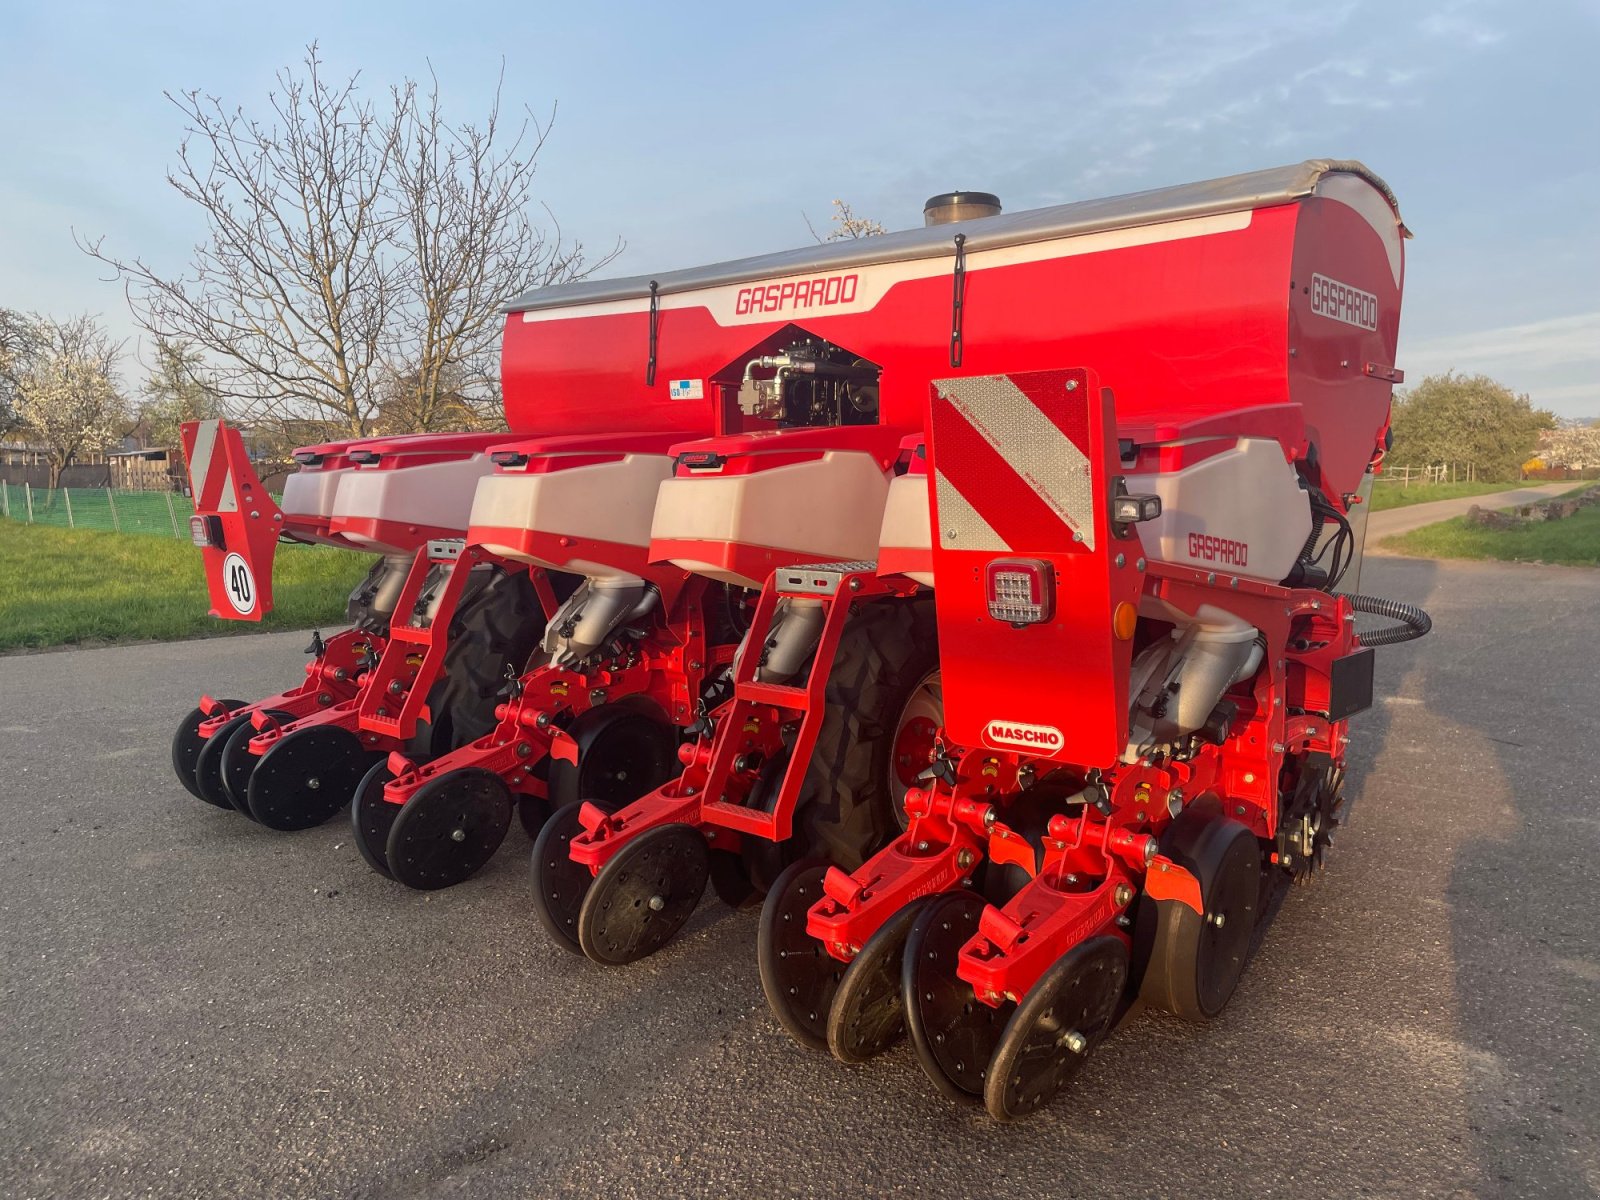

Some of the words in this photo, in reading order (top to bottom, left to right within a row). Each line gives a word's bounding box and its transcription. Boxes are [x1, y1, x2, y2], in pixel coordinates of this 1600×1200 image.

[735, 274, 859, 315] GASPARDO
[1312, 276, 1377, 329] GASPARDO
[1188, 532, 1248, 567] GASPARDO
[231, 565, 251, 602] 40
[992, 726, 1059, 745] MASCHIO
